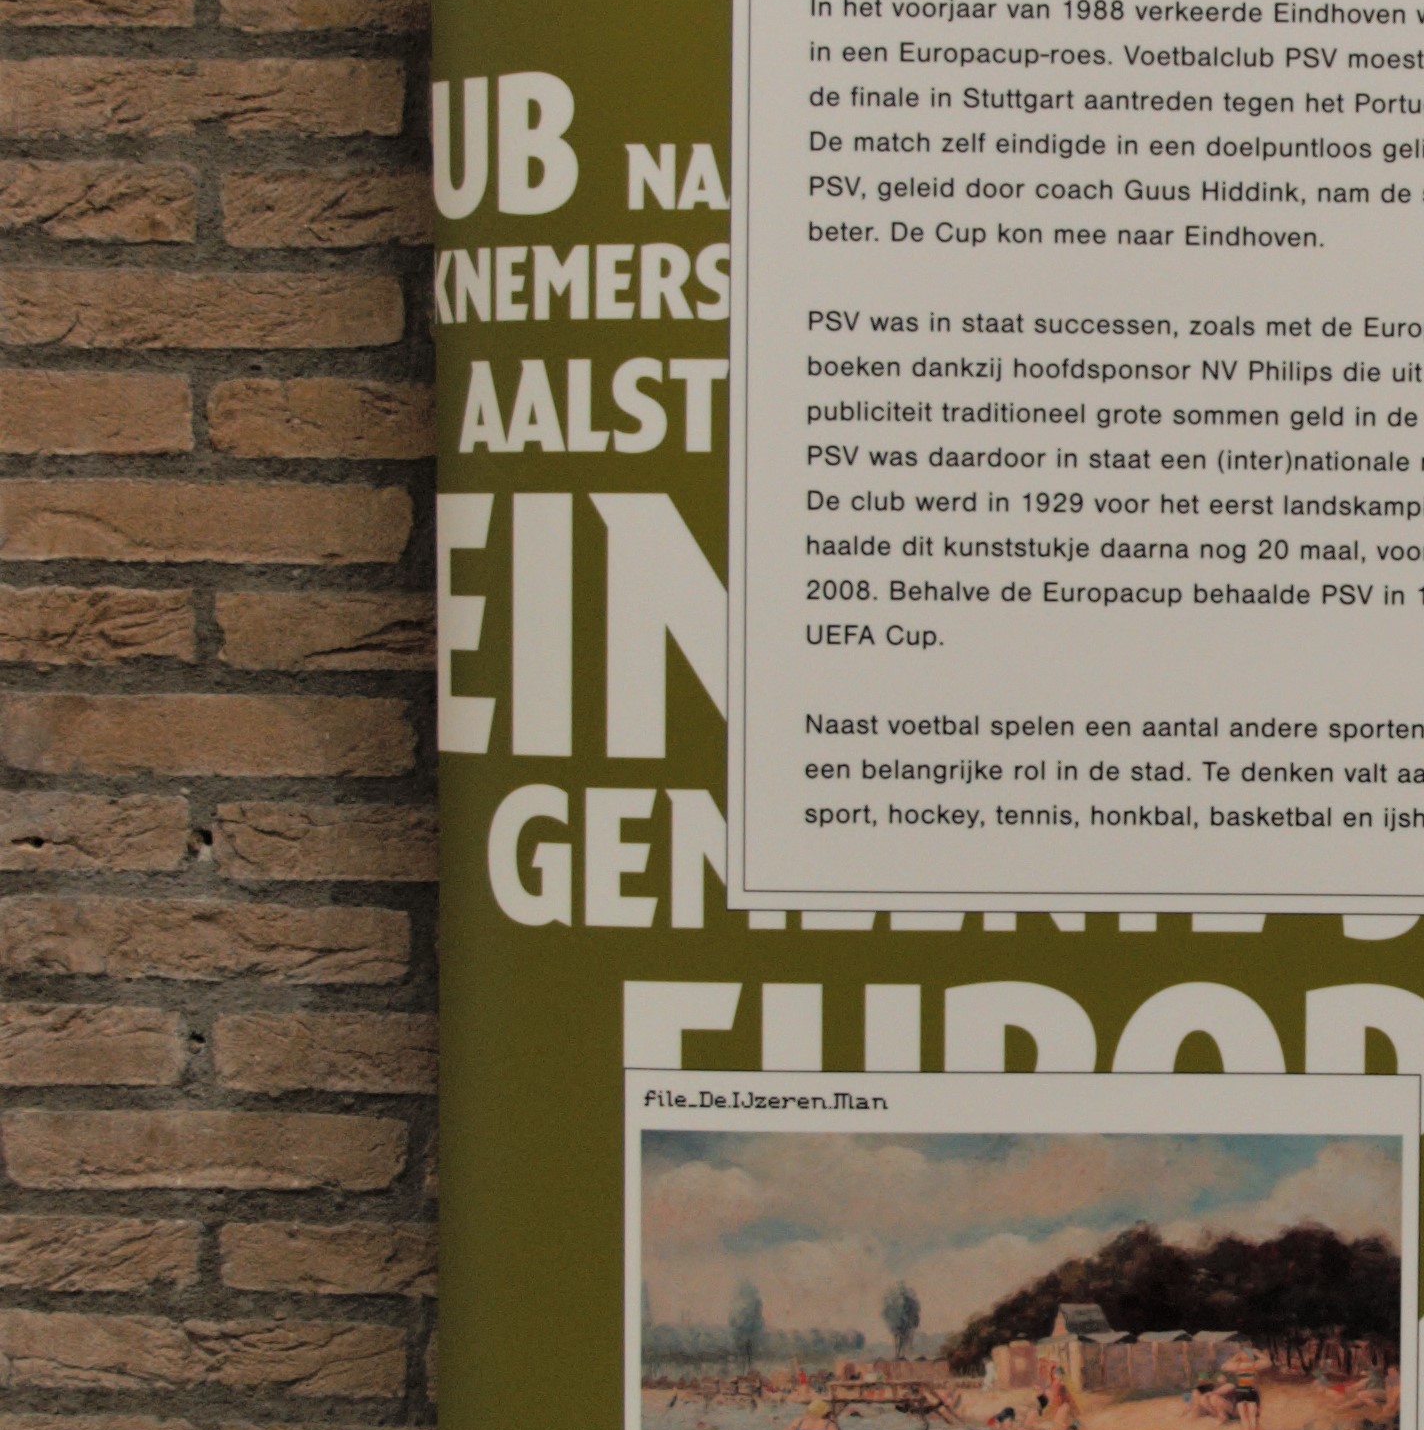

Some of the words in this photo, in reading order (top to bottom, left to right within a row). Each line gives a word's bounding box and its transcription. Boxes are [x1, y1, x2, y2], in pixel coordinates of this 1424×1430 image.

[1006, 2, 1051, 20] van
[1134, 0, 1263, 24] verkeerde
[1273, 1, 1406, 25] Eindhoven
[809, 40, 831, 62] in
[841, 45, 888, 63] een
[899, 41, 1113, 69] Europacup-roes.
[1123, 44, 1275, 69] Voetbalclub
[1285, 46, 1338, 69] PSV
[1347, 49, 1424, 70] moest
[809, 130, 843, 153] De
[853, 131, 931, 153] match
[941, 131, 987, 154] zelf
[995, 132, 1107, 160] eindigde
[1117, 134, 1139, 156] in
[1148, 139, 1195, 157] een
[1205, 135, 1373, 162] doelpuntloos
[625, 143, 730, 211] NA
[808, 220, 879, 243] beter.
[890, 220, 925, 243] De
[934, 221, 987, 248] Cup
[997, 222, 1043, 245] kon
[1053, 227, 1107, 246] mee
[1117, 228, 1175, 246] naar
[1184, 224, 1325, 248] Eindhoven.
[808, 309, 861, 332] PSV
[869, 315, 920, 333] was
[929, 311, 951, 333] in
[961, 312, 1025, 334] staat
[1033, 317, 1179, 339] successen,
[1188, 315, 1256, 337] zoals
[1265, 316, 1312, 338] met
[1321, 316, 1353, 338] de
[807, 355, 901, 378] boeken
[911, 356, 1002, 383] dankzij
[1013, 357, 1192, 384] hoofdsponsor
[1201, 359, 1238, 381] NV
[1248, 359, 1334, 386] Philips
[1342, 361, 1382, 383] die
[1391, 361, 1423, 384] uit
[459, 356, 727, 453] AALST
[807, 444, 860, 467] PSV
[868, 450, 919, 468] was
[928, 446, 1047, 469] daardoor
[1056, 447, 1078, 469] in
[1088, 448, 1152, 470] staat
[1160, 453, 1207, 471] een
[1217, 449, 1411, 475] (inter)nationale
[806, 534, 892, 557] haalde
[901, 535, 934, 557] dit
[943, 535, 1090, 563] kunststukje
[1100, 537, 1190, 560] daarna
[1199, 542, 1247, 565] nog
[1257, 538, 1290, 561] 20
[1299, 539, 1367, 564] maal,
[806, 623, 876, 646] UEFA
[885, 624, 944, 651] Cup.
[805, 713, 879, 736] Naast
[887, 714, 980, 737] voetbal
[990, 715, 1075, 741] spelen
[1085, 720, 1132, 738] een
[1141, 716, 1219, 738] aantal
[1229, 716, 1319, 739] andere
[1328, 718, 1424, 743] sporten
[804, 762, 851, 780] een
[861, 758, 1004, 785] belangrijke
[1013, 759, 1046, 781] rol
[1056, 759, 1078, 781] in
[1088, 760, 1121, 782] de
[1130, 760, 1192, 783] stad.
[1201, 760, 1231, 783] Te
[1240, 761, 1334, 784] denken
[1343, 762, 1388, 784] valt
[804, 804, 878, 828] sport,
[888, 803, 986, 830] hockey,
[995, 804, 1080, 829] tennis,
[1090, 804, 1199, 830] honkbal,
[1209, 805, 1332, 828] basketbal
[1342, 811, 1373, 828] en
